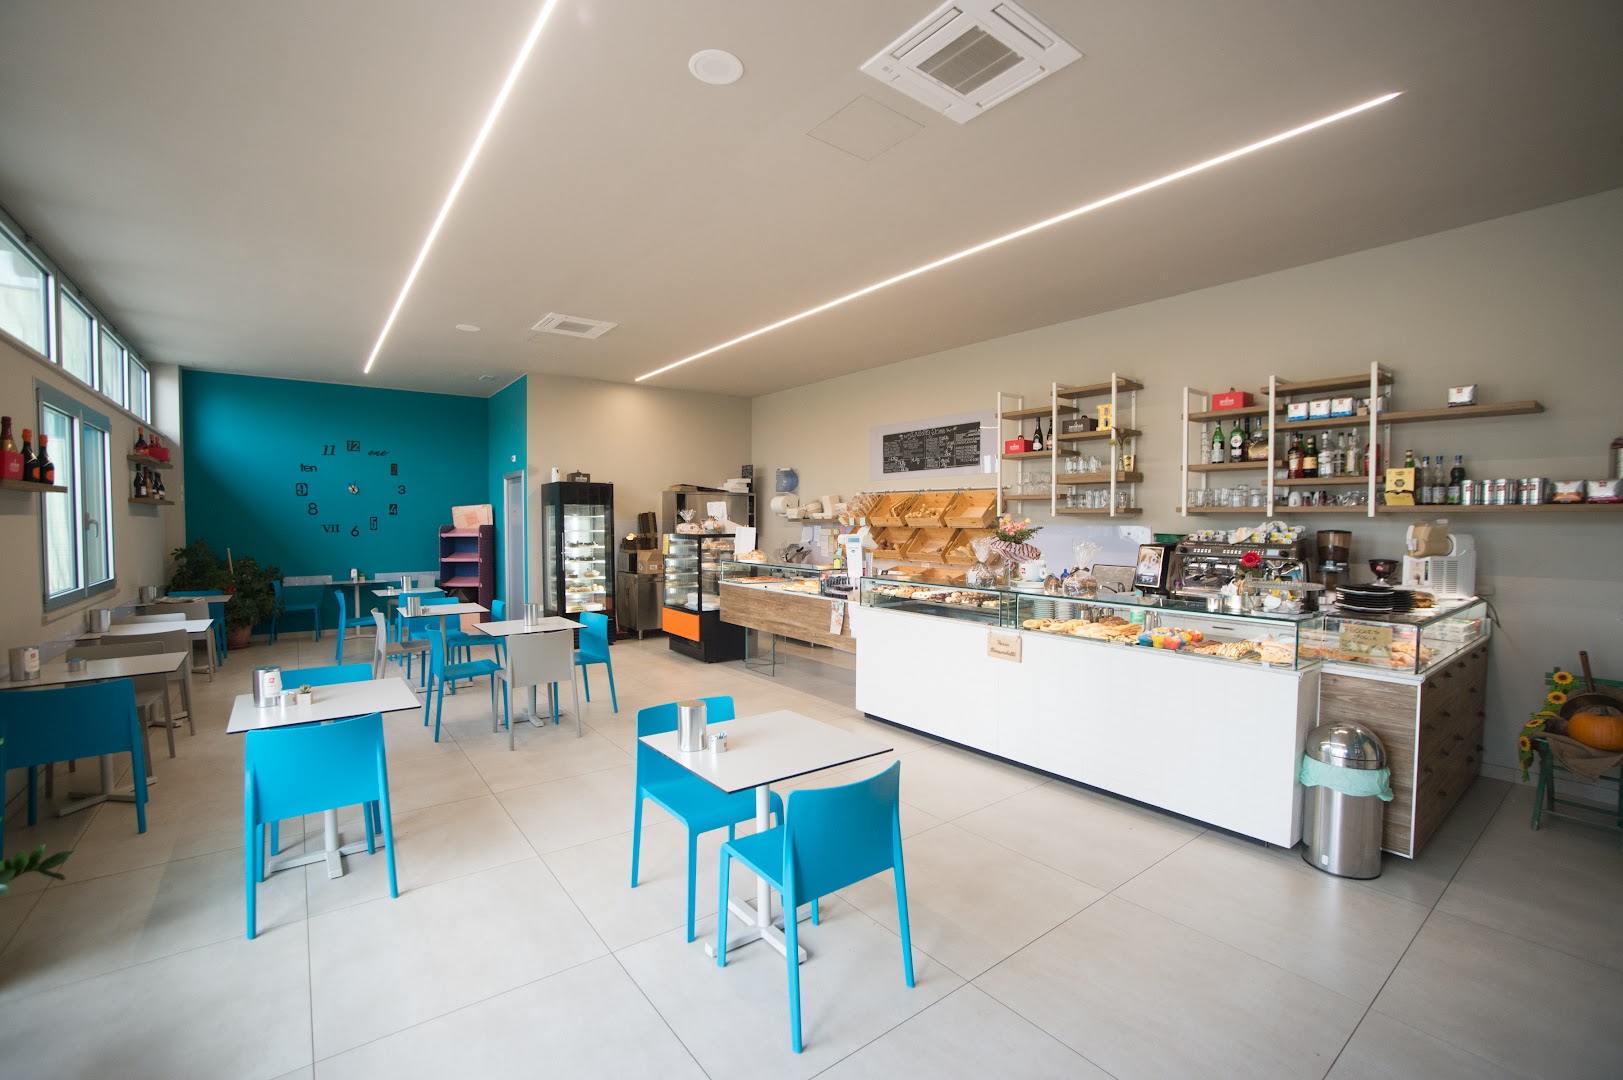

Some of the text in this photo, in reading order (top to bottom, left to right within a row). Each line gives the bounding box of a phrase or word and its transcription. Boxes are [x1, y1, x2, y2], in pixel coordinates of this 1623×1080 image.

[321, 445, 335, 455] 11
[347, 440, 360, 451] 12
[300, 463, 317, 472] ten
[398, 485, 405, 494] 3
[308, 502, 318, 515] 8
[389, 504, 397, 515] 4
[322, 524, 340, 533] VII
[351, 525, 360, 537] 6
